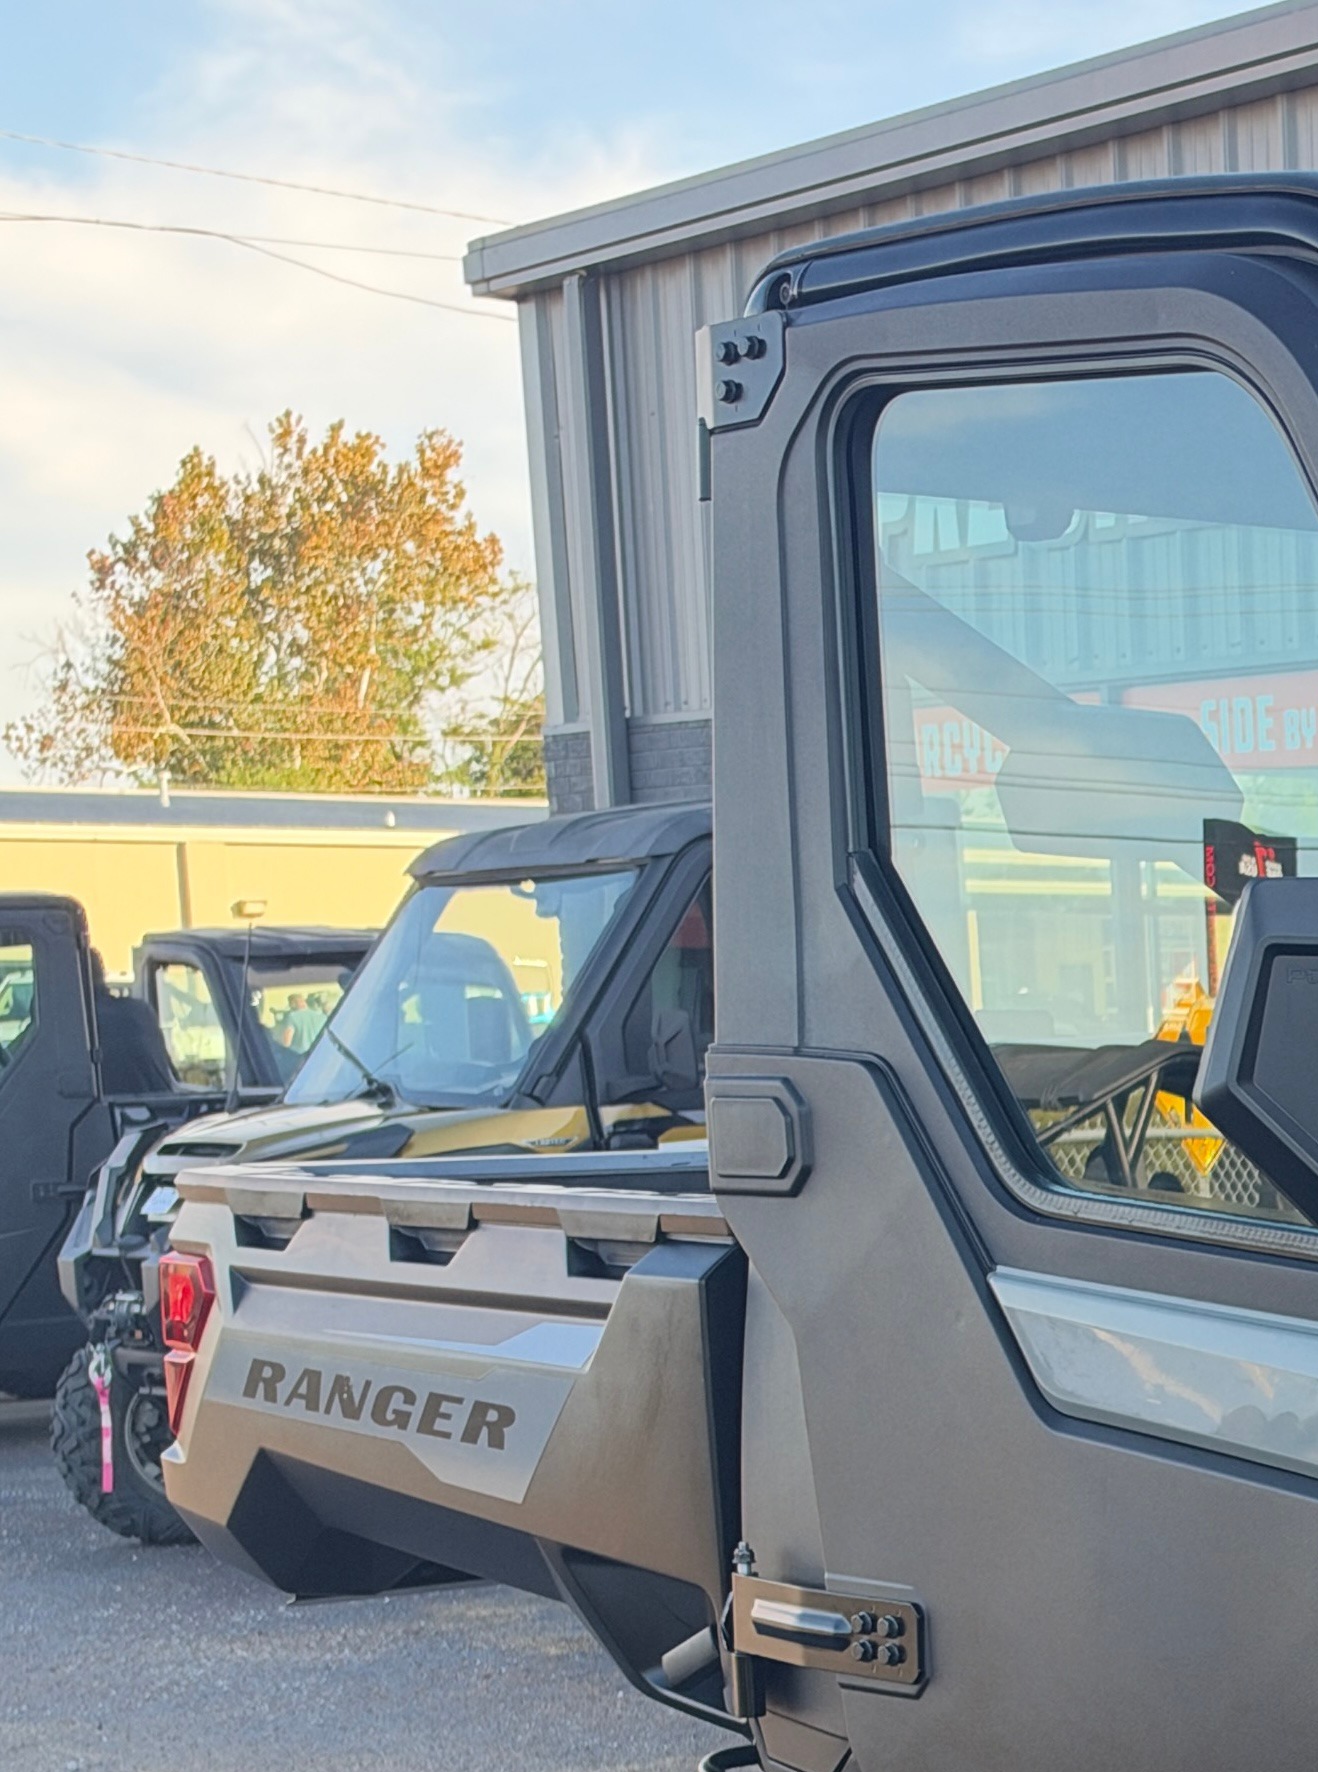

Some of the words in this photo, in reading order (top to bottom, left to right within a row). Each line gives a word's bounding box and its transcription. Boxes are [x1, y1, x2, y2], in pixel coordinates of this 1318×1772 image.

[1201, 694, 1276, 755] SIDE
[1284, 706, 1316, 750] BY
[242, 1358, 516, 1450] RANGER
